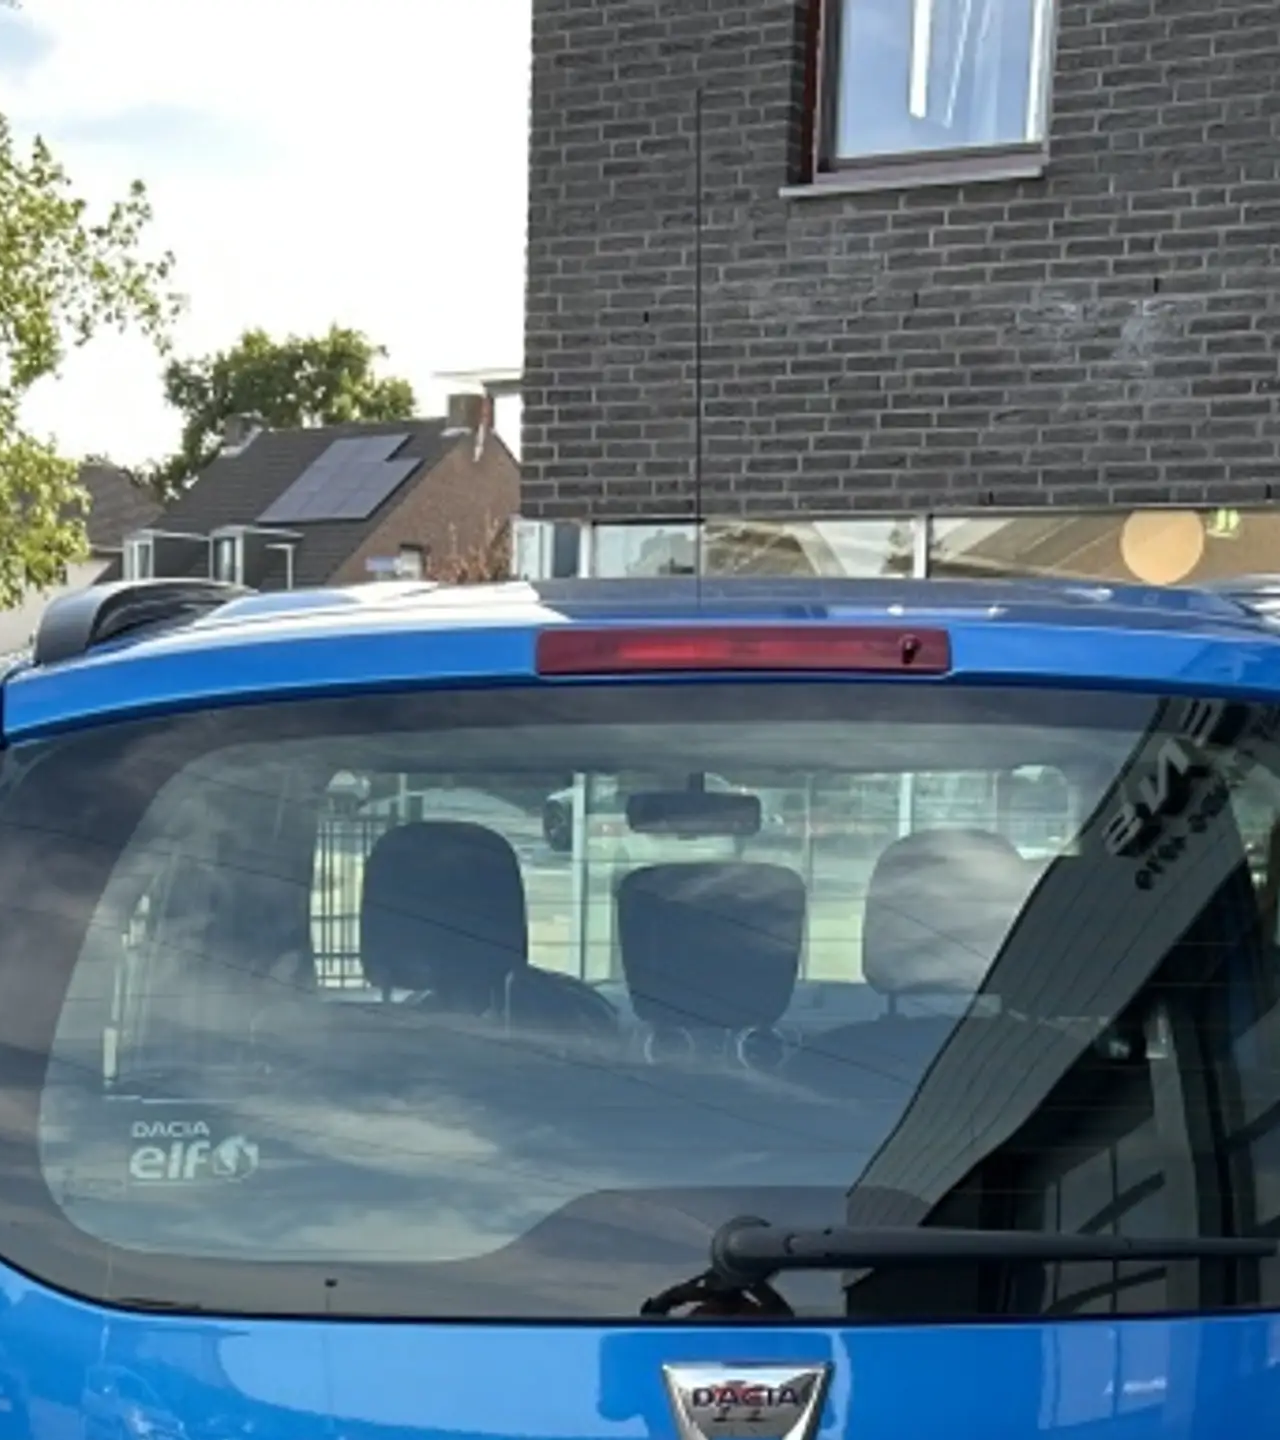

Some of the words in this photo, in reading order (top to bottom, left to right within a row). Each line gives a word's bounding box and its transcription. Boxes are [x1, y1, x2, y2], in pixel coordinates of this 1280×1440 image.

[132, 1121, 211, 1138] DACIA
[129, 1140, 211, 1180] elf
[692, 1387, 800, 1407] DACIA
